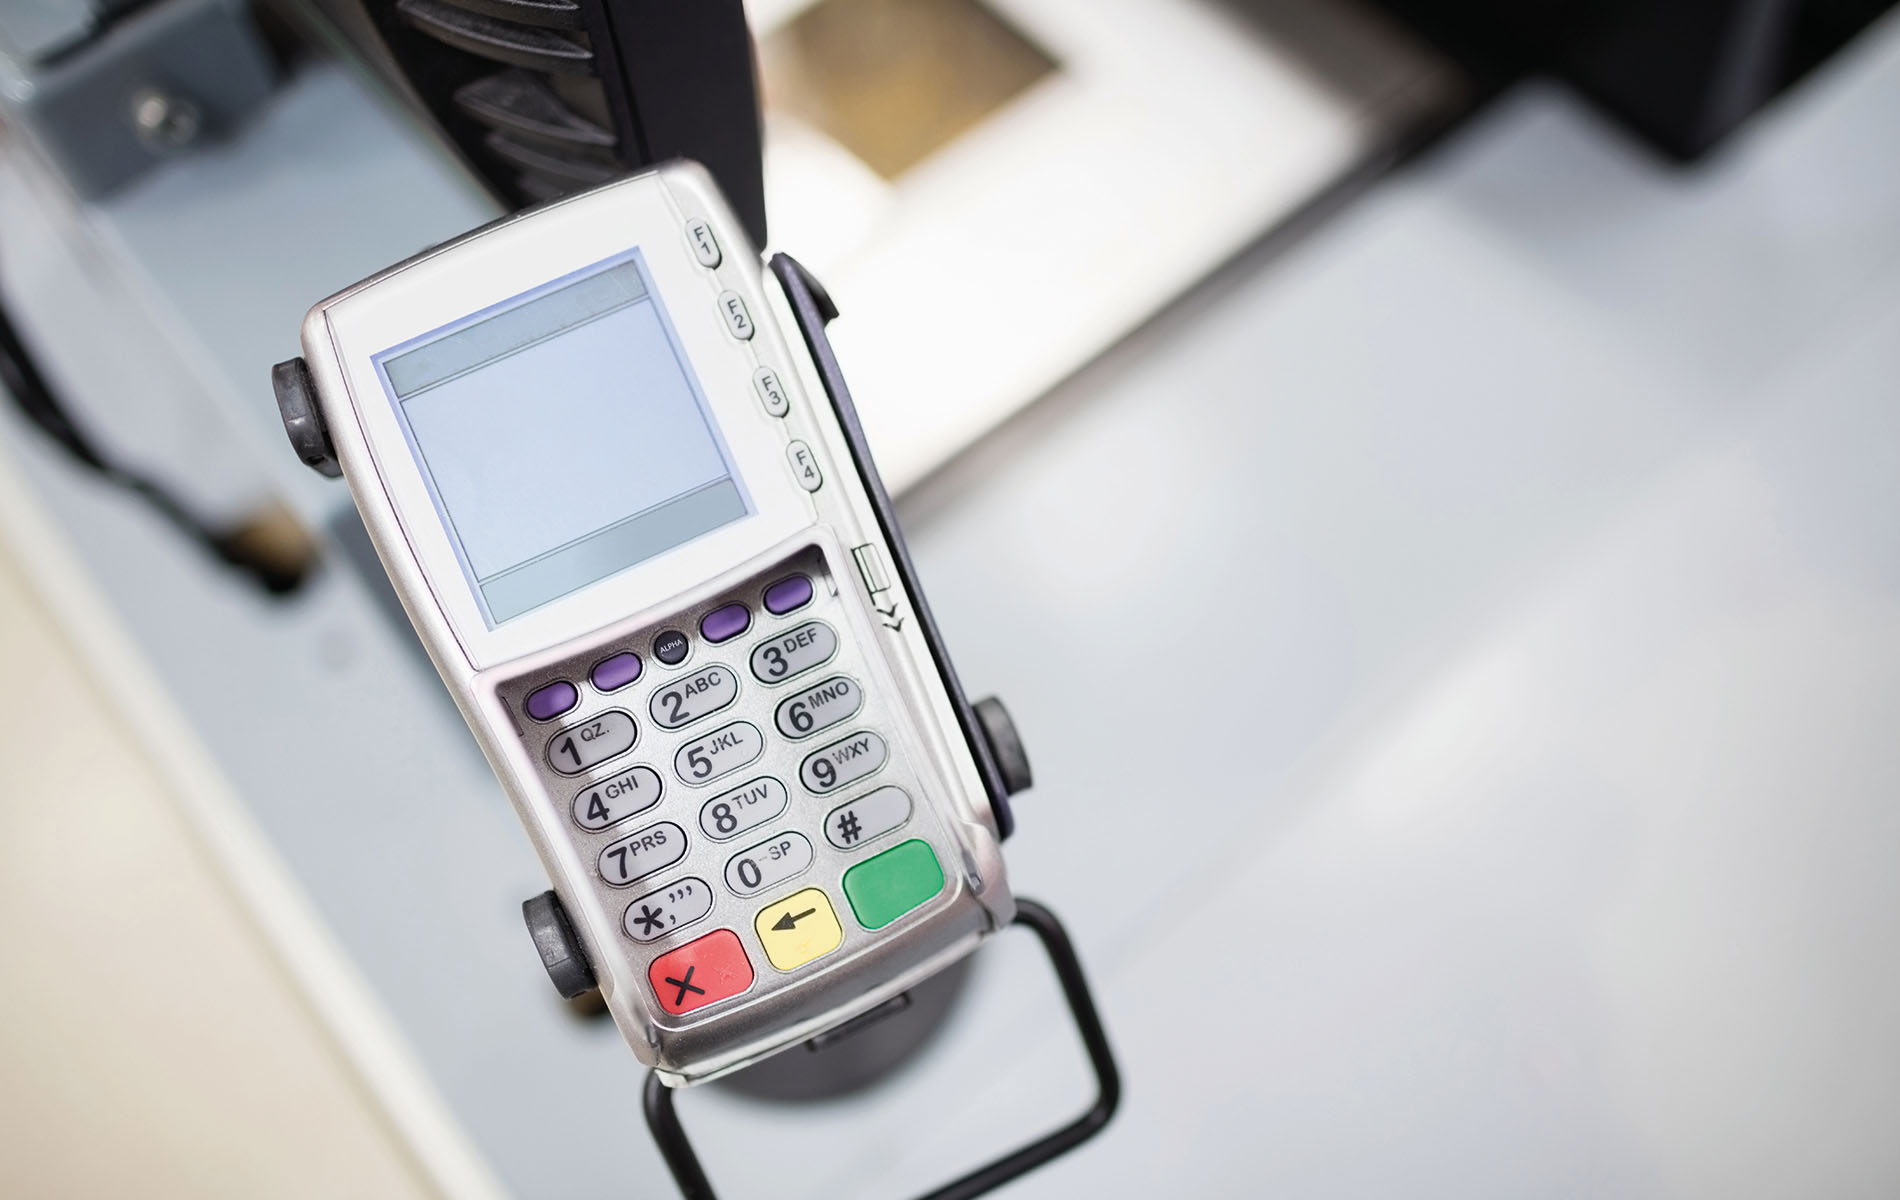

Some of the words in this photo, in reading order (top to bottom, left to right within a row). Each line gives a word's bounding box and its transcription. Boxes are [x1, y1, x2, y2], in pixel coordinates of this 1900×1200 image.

[660, 639, 683, 654] ALPHA
[762, 647, 788, 677] 3
[783, 628, 818, 653] DEF
[661, 692, 690, 723] 2
[685, 672, 721, 698] ABC
[788, 702, 814, 732] 6
[807, 681, 849, 709] MNO
[560, 737, 582, 766] 1
[687, 746, 713, 778] 5
[709, 732, 743, 755] JKL
[811, 758, 837, 788] 9
[832, 738, 870, 765] WXY
[587, 792, 610, 821] 4
[605, 775, 639, 799] GHI
[711, 803, 738, 833] 8
[731, 784, 768, 810] TUV
[837, 810, 862, 844] #
[607, 846, 627, 879] 7
[629, 831, 667, 856] PRS
[737, 858, 762, 888] 0
